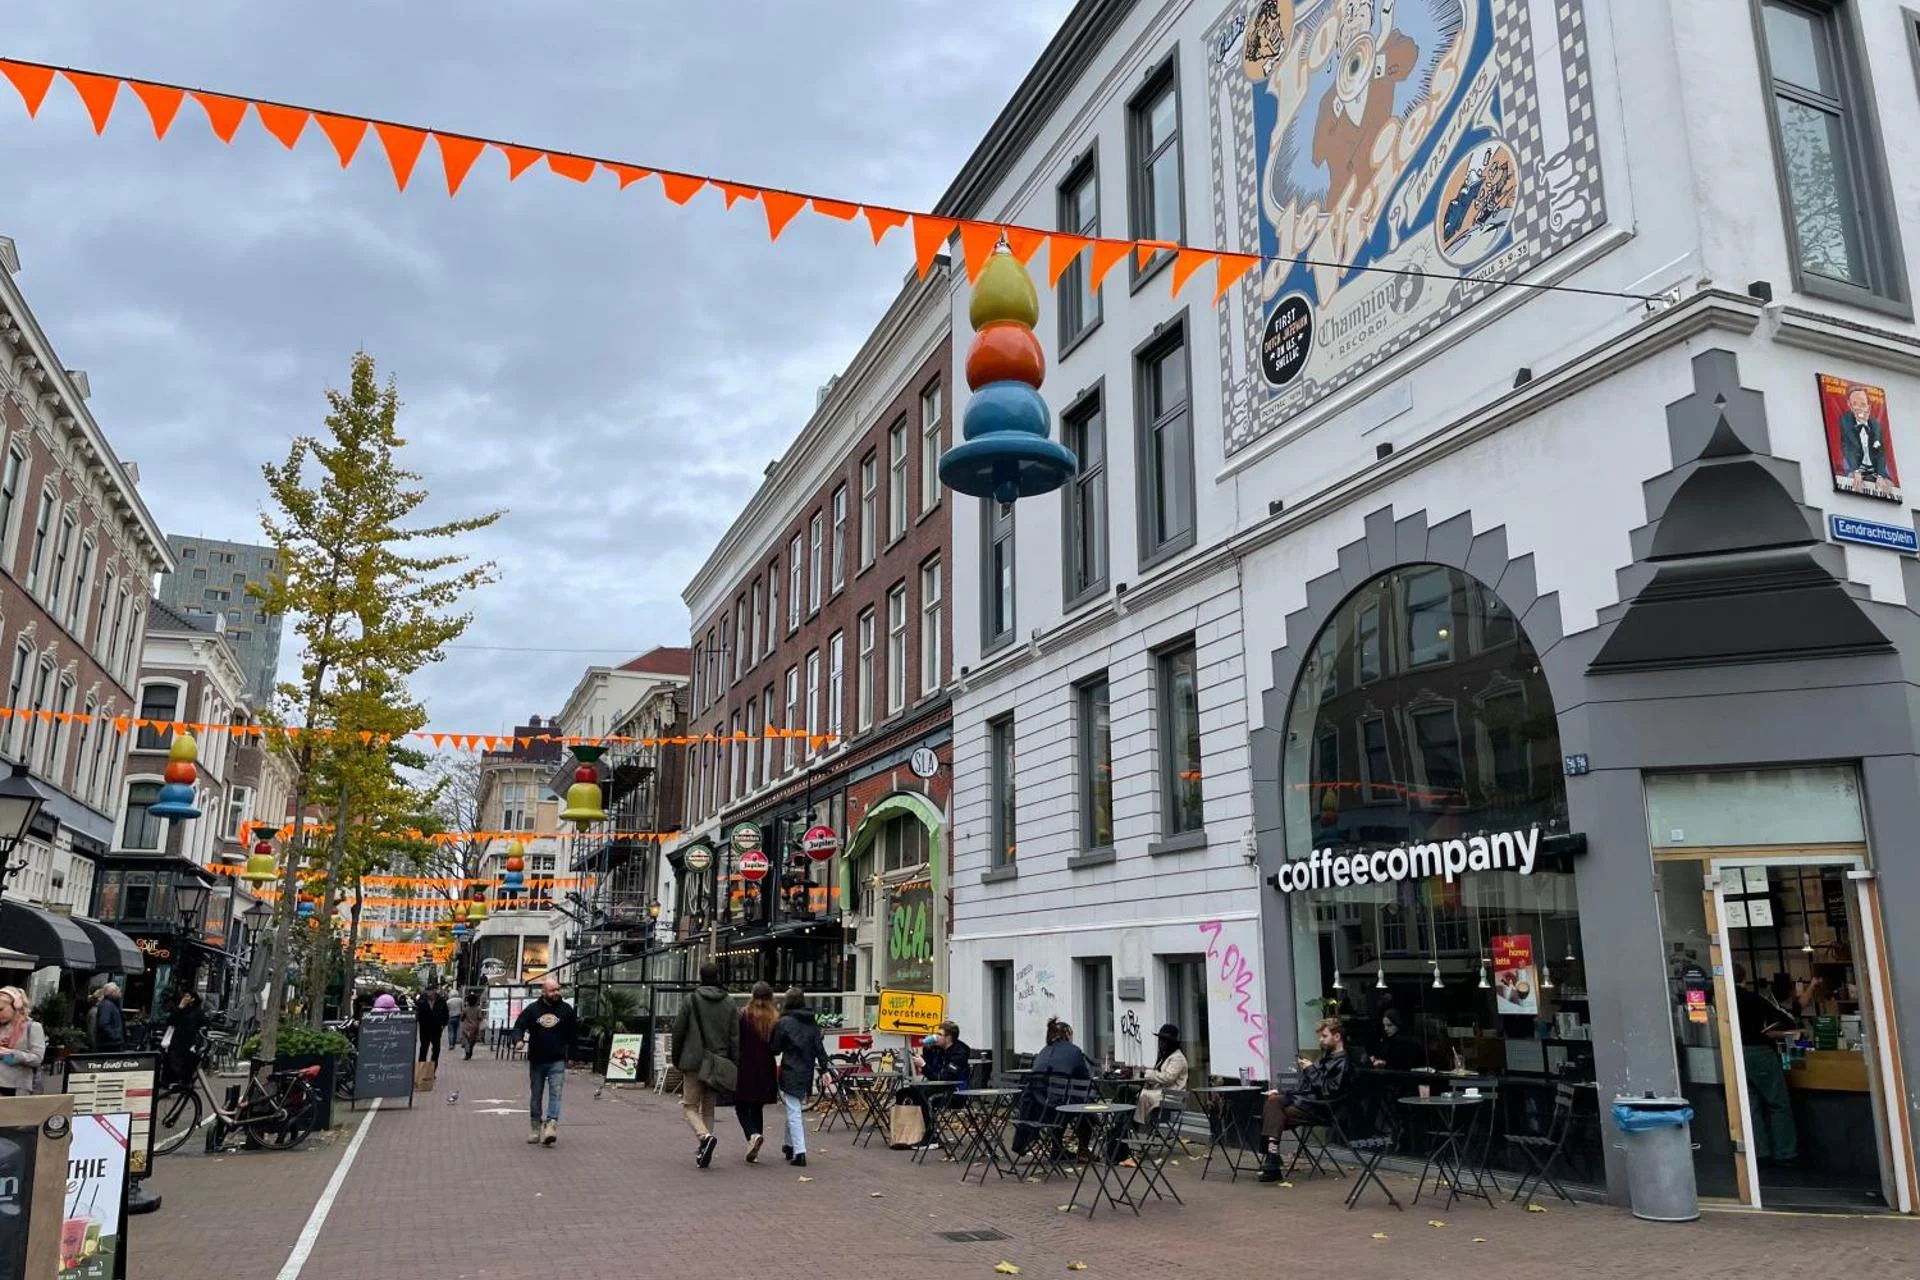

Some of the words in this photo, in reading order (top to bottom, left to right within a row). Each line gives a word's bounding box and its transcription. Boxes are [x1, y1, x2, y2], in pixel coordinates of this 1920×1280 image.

[1274, 307, 1297, 333] FIRST
[1317, 282, 1397, 348] Champion
[1339, 315, 1388, 355] RECORDS
[1838, 520, 1914, 544] Eendrachtsplein
[914, 751, 935, 774] SLA
[1277, 827, 1540, 893] coffeecompany
[881, 1008, 938, 1020] oversteken
